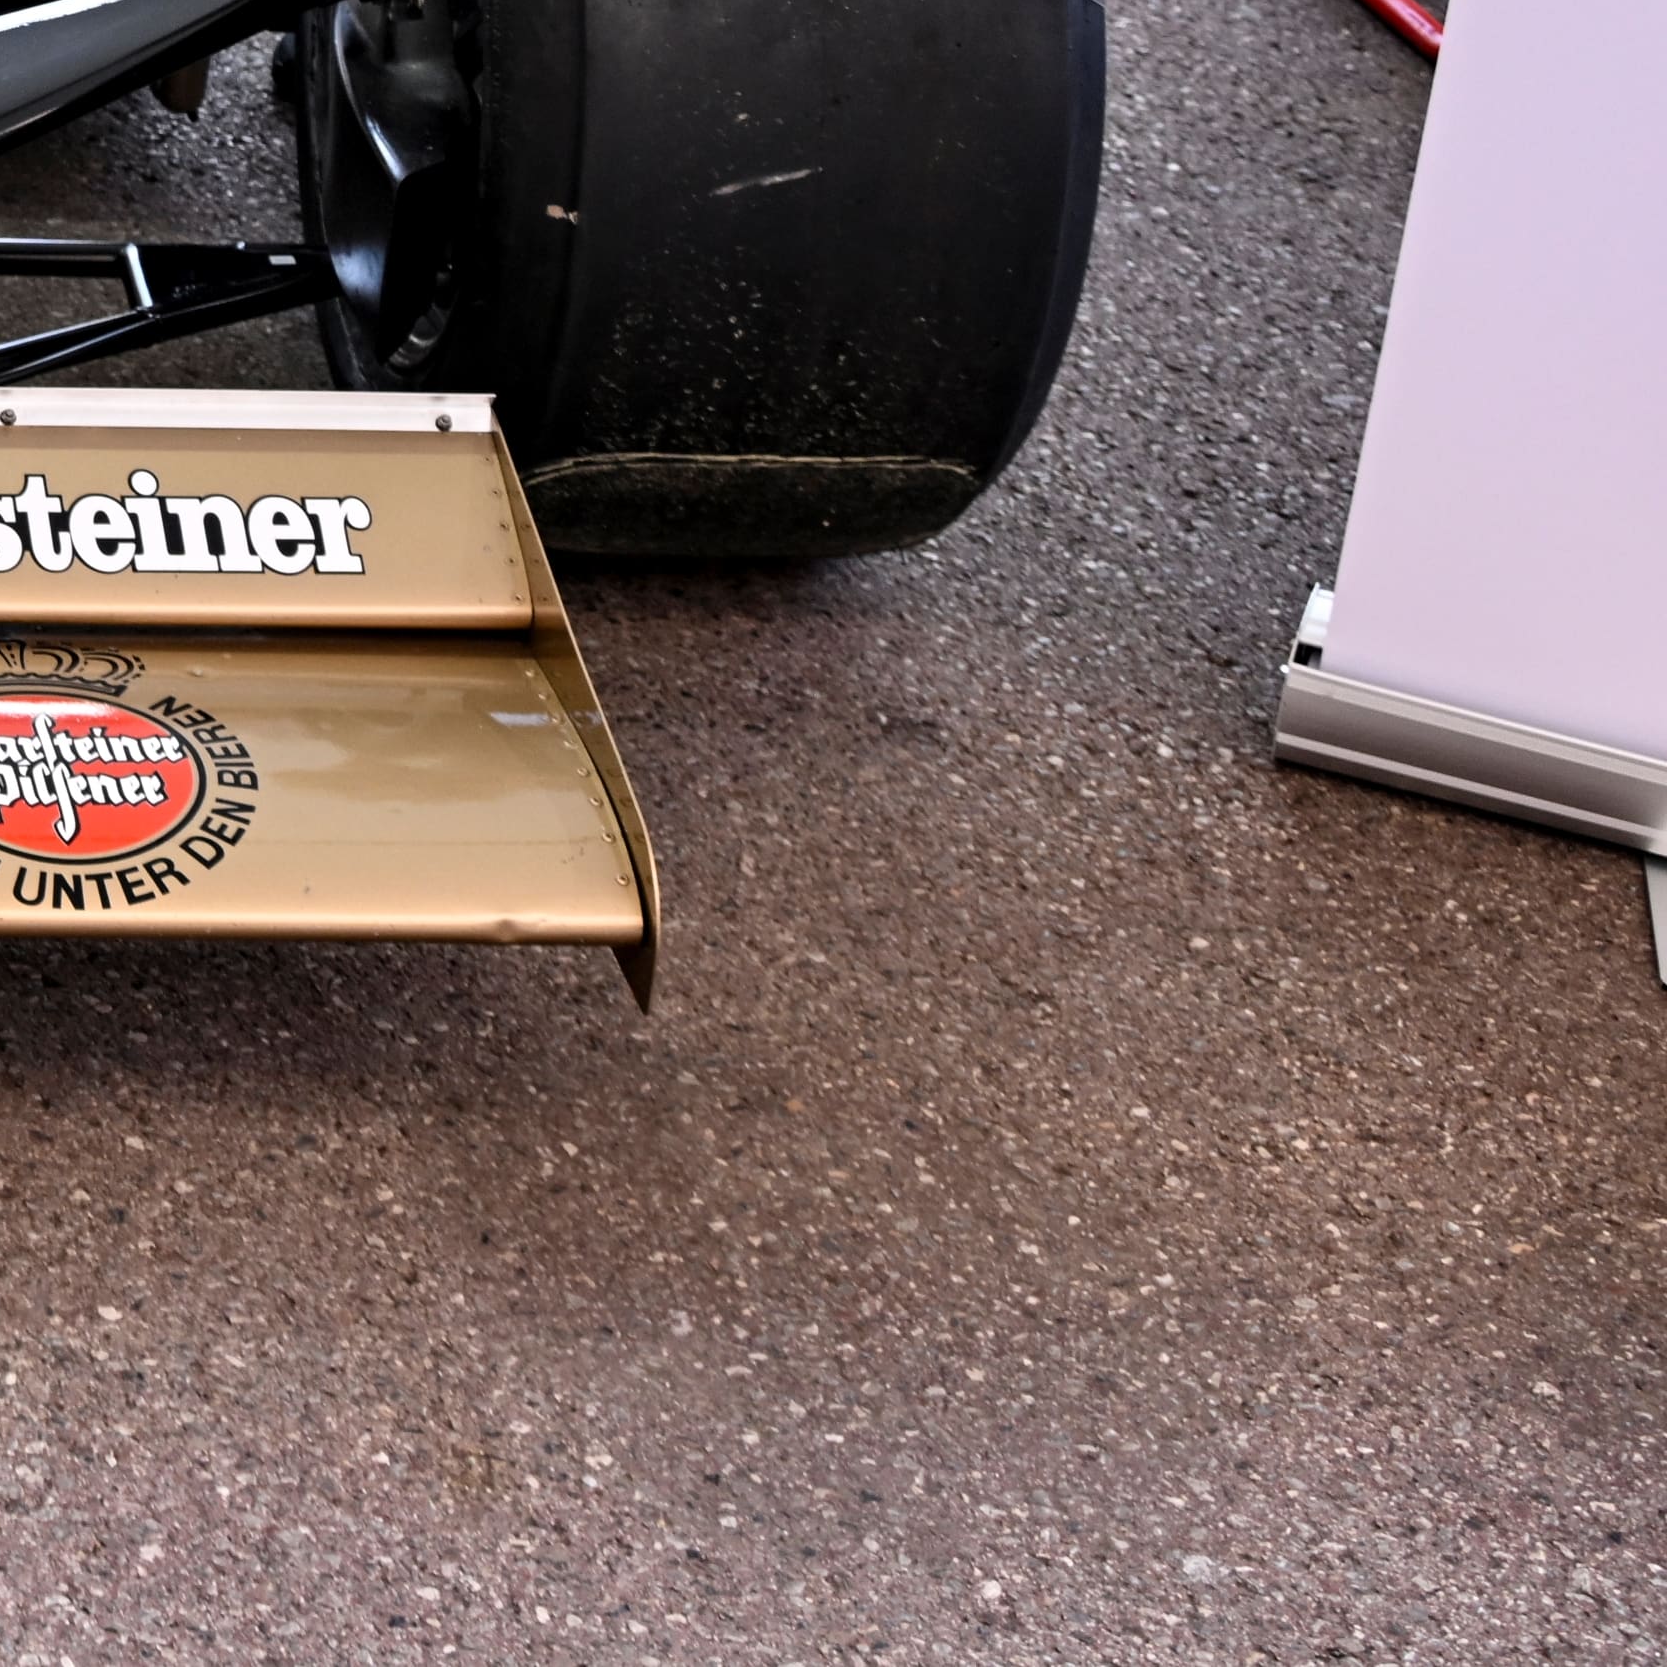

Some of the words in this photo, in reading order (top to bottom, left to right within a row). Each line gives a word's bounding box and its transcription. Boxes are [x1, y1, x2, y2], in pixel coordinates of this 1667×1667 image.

[148, 695, 259, 791] BIEREN
[178, 797, 257, 871] DEN
[12, 857, 191, 911] UNTER
